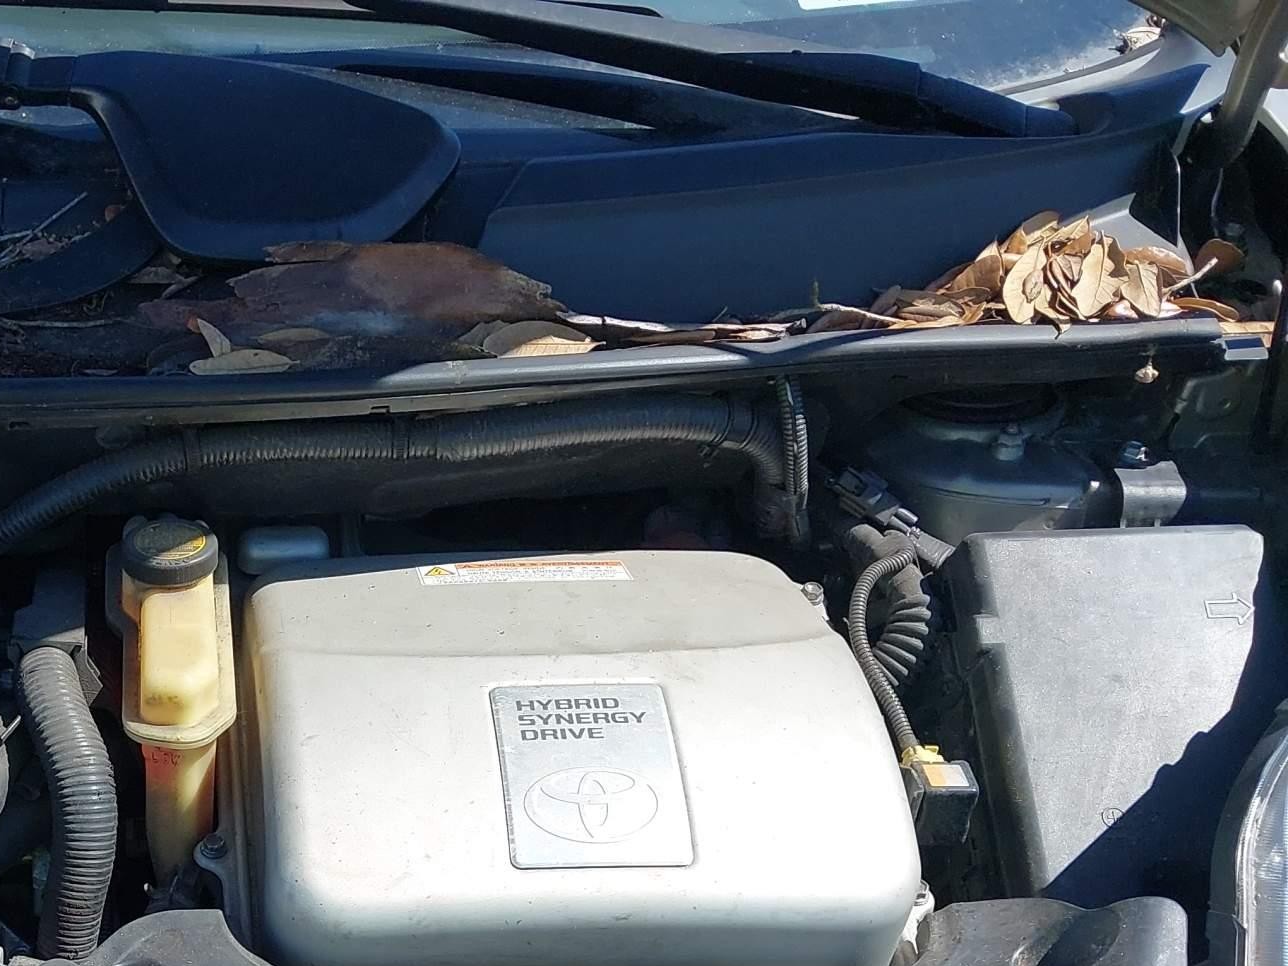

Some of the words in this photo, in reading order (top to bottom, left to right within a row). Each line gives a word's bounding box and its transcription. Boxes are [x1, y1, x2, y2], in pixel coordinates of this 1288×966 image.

[515, 697, 620, 711] HYBRID
[518, 711, 646, 726] SYNERGY
[520, 727, 605, 741] DRIVE
